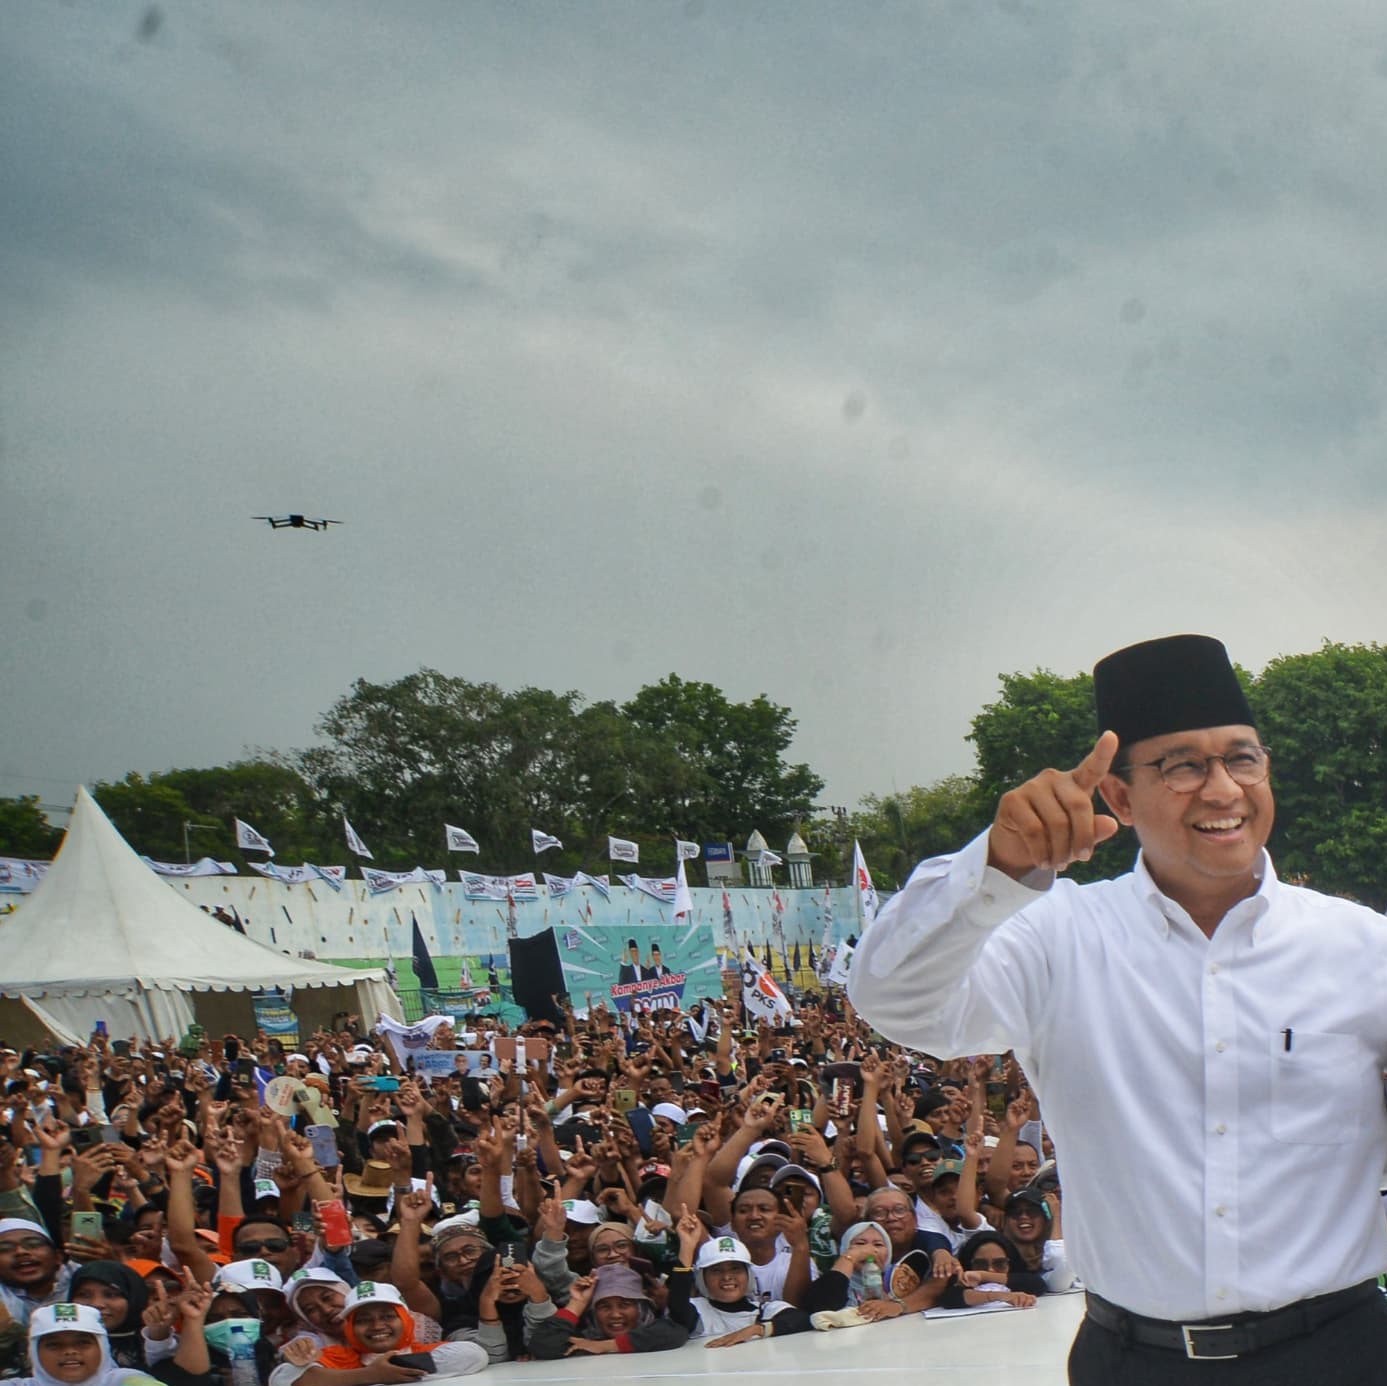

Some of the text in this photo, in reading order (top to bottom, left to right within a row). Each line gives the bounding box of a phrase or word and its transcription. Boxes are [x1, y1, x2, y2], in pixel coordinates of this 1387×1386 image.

[610, 970, 685, 998] Kampanye Akbar
[751, 989, 776, 1009] PKS
